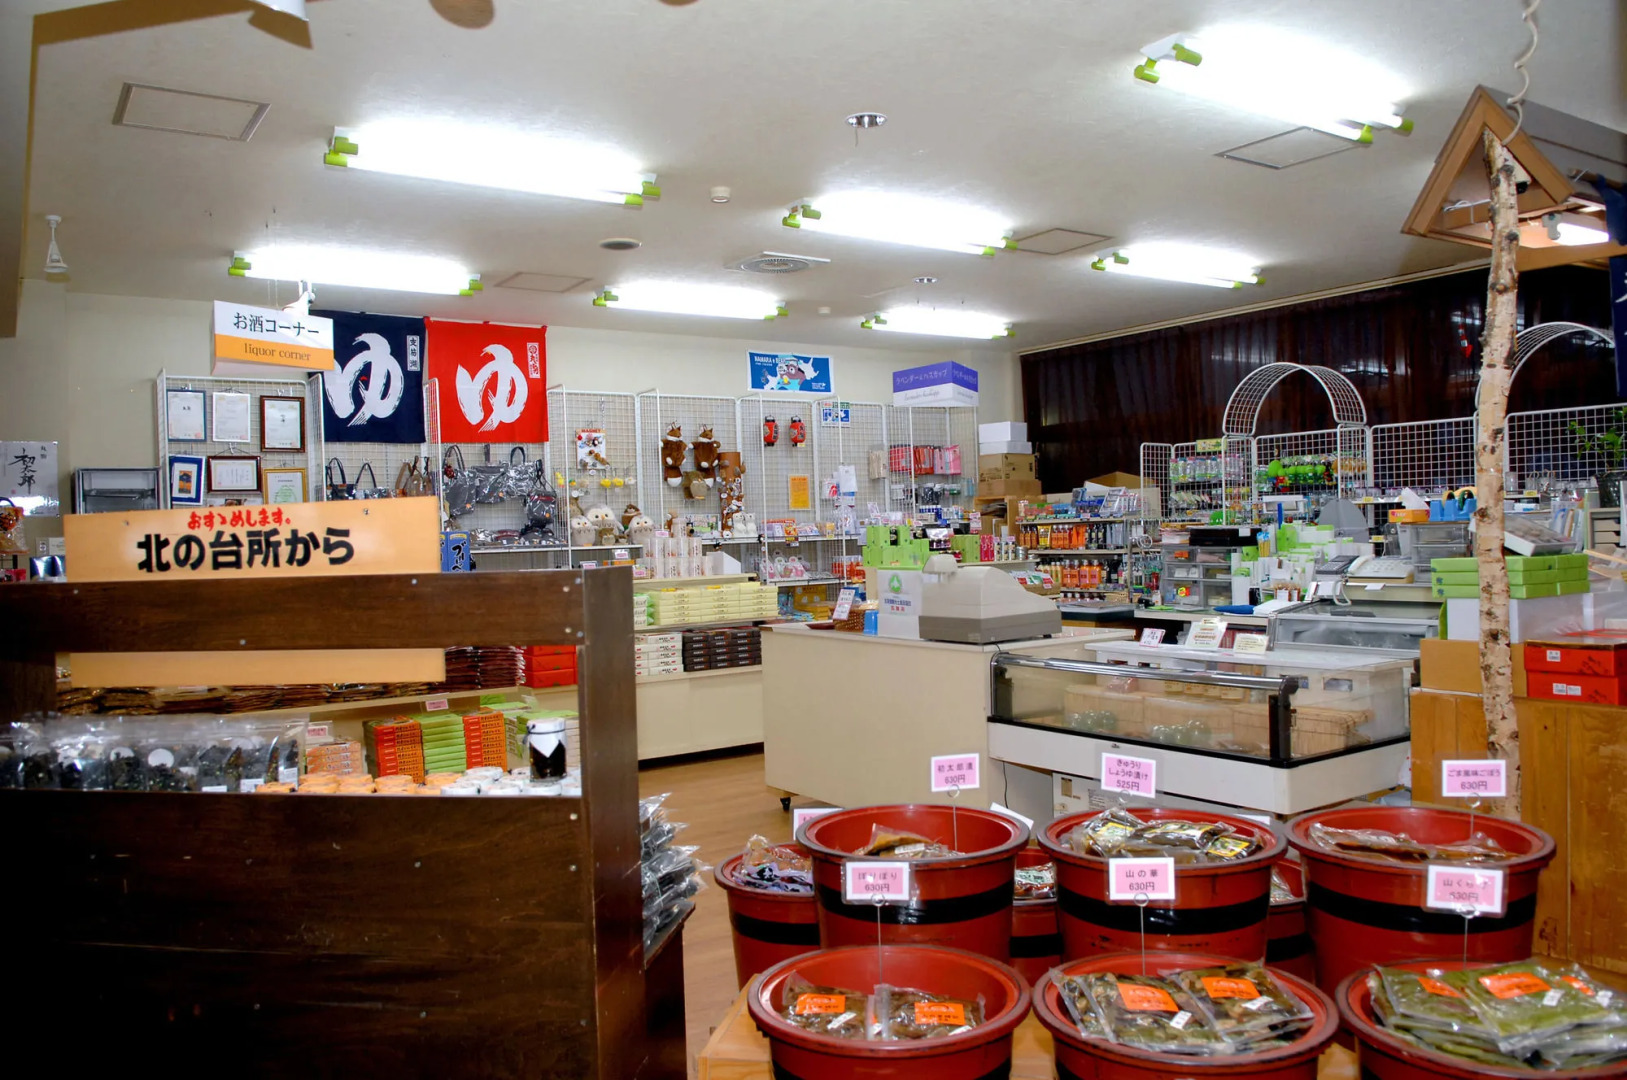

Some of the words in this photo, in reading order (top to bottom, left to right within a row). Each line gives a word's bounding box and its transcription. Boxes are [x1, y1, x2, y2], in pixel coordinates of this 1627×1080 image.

[233, 312, 319, 336] お酒コーナー
[244, 342, 276, 357] liquor
[279, 350, 311, 361] corner
[137, 526, 355, 573] 北の台所から
[1116, 758, 1141, 769] きゅうり
[944, 774, 966, 784] 630円
[1108, 768, 1148, 780] しょうゆ漬け
[1116, 780, 1140, 791] 525円
[1460, 780, 1488, 790] 630円
[864, 883, 890, 892] 630円
[1128, 882, 1156, 891] 630円
